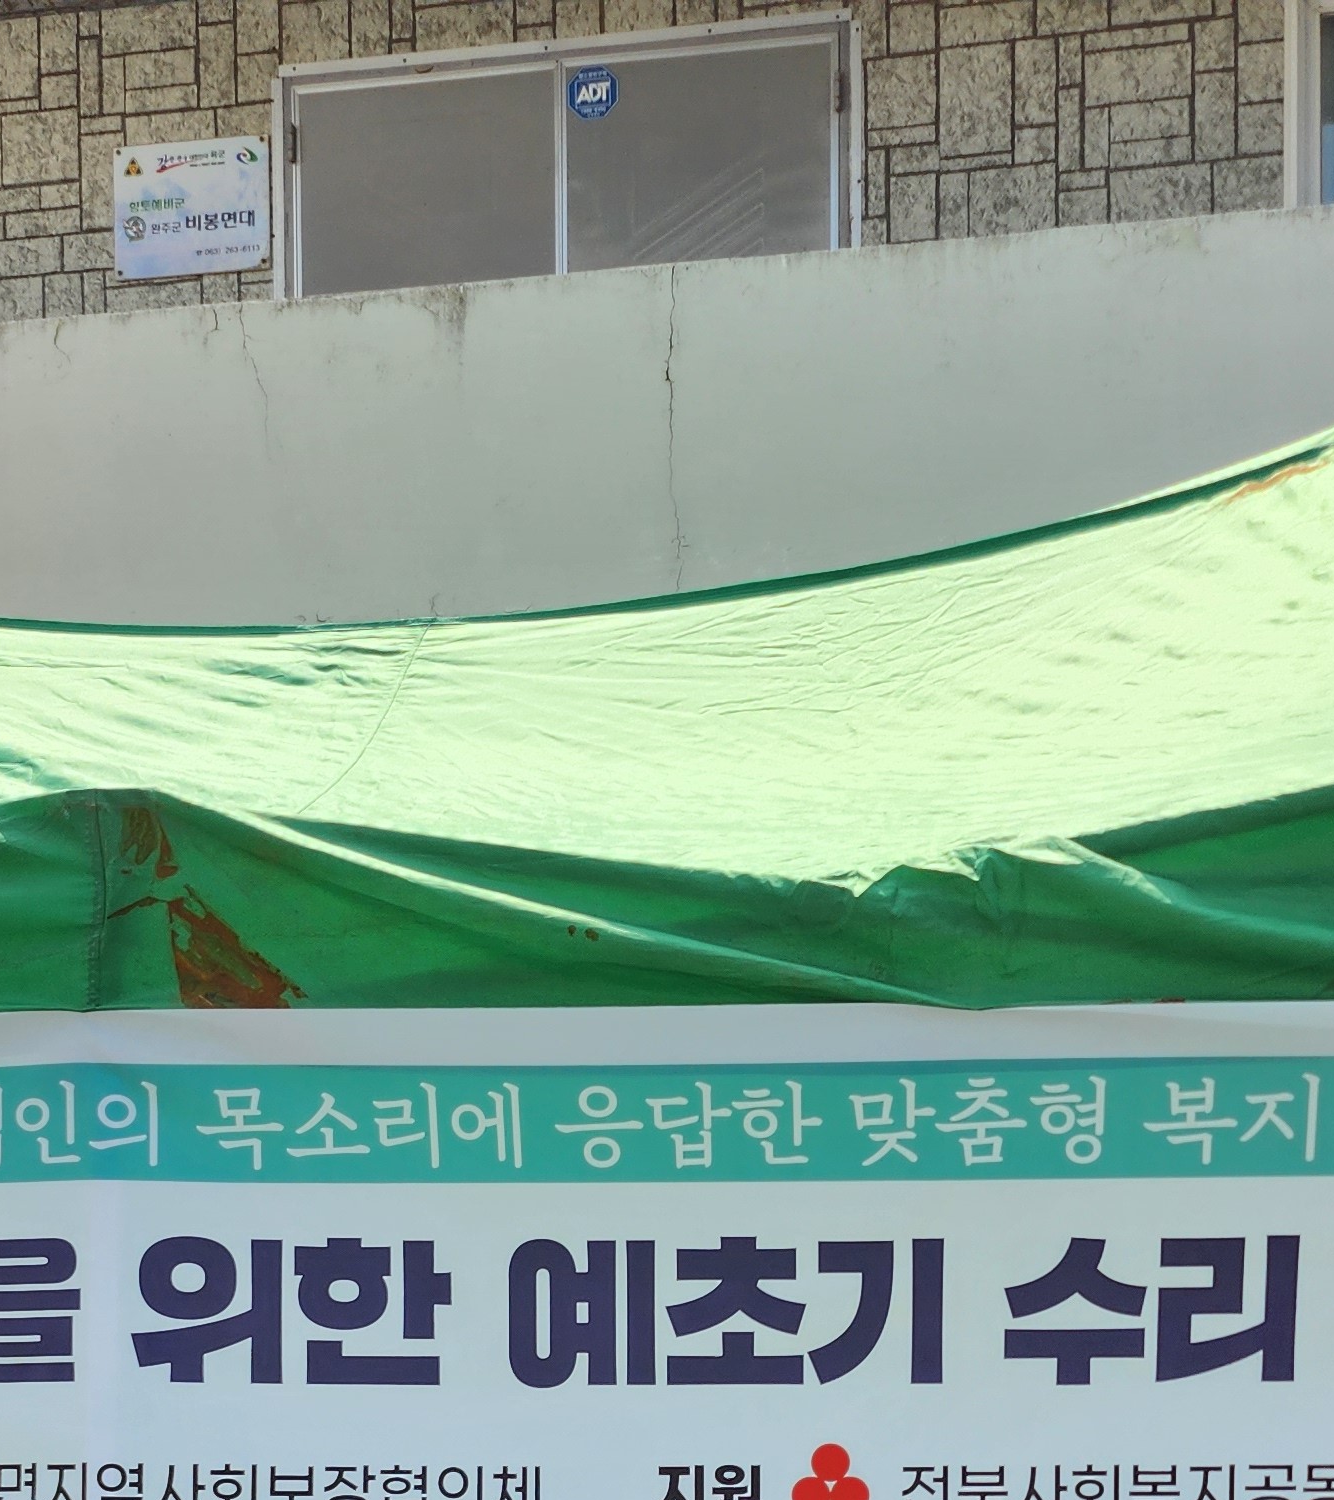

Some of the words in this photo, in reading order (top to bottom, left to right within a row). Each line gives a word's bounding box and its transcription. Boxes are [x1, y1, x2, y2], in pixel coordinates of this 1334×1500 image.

[577, 82, 610, 104] ADT
[185, 209, 256, 231] 비봉면대
[195, 1081, 523, 1171] 목소리에
[554, 1080, 823, 1169] 응답한
[849, 1076, 1108, 1167] 맞춤형
[1142, 1073, 1321, 1164] 복지
[130, 1236, 452, 1386] 위한
[507, 1236, 945, 1389] 예초기
[1003, 1234, 1301, 1386] 수리
